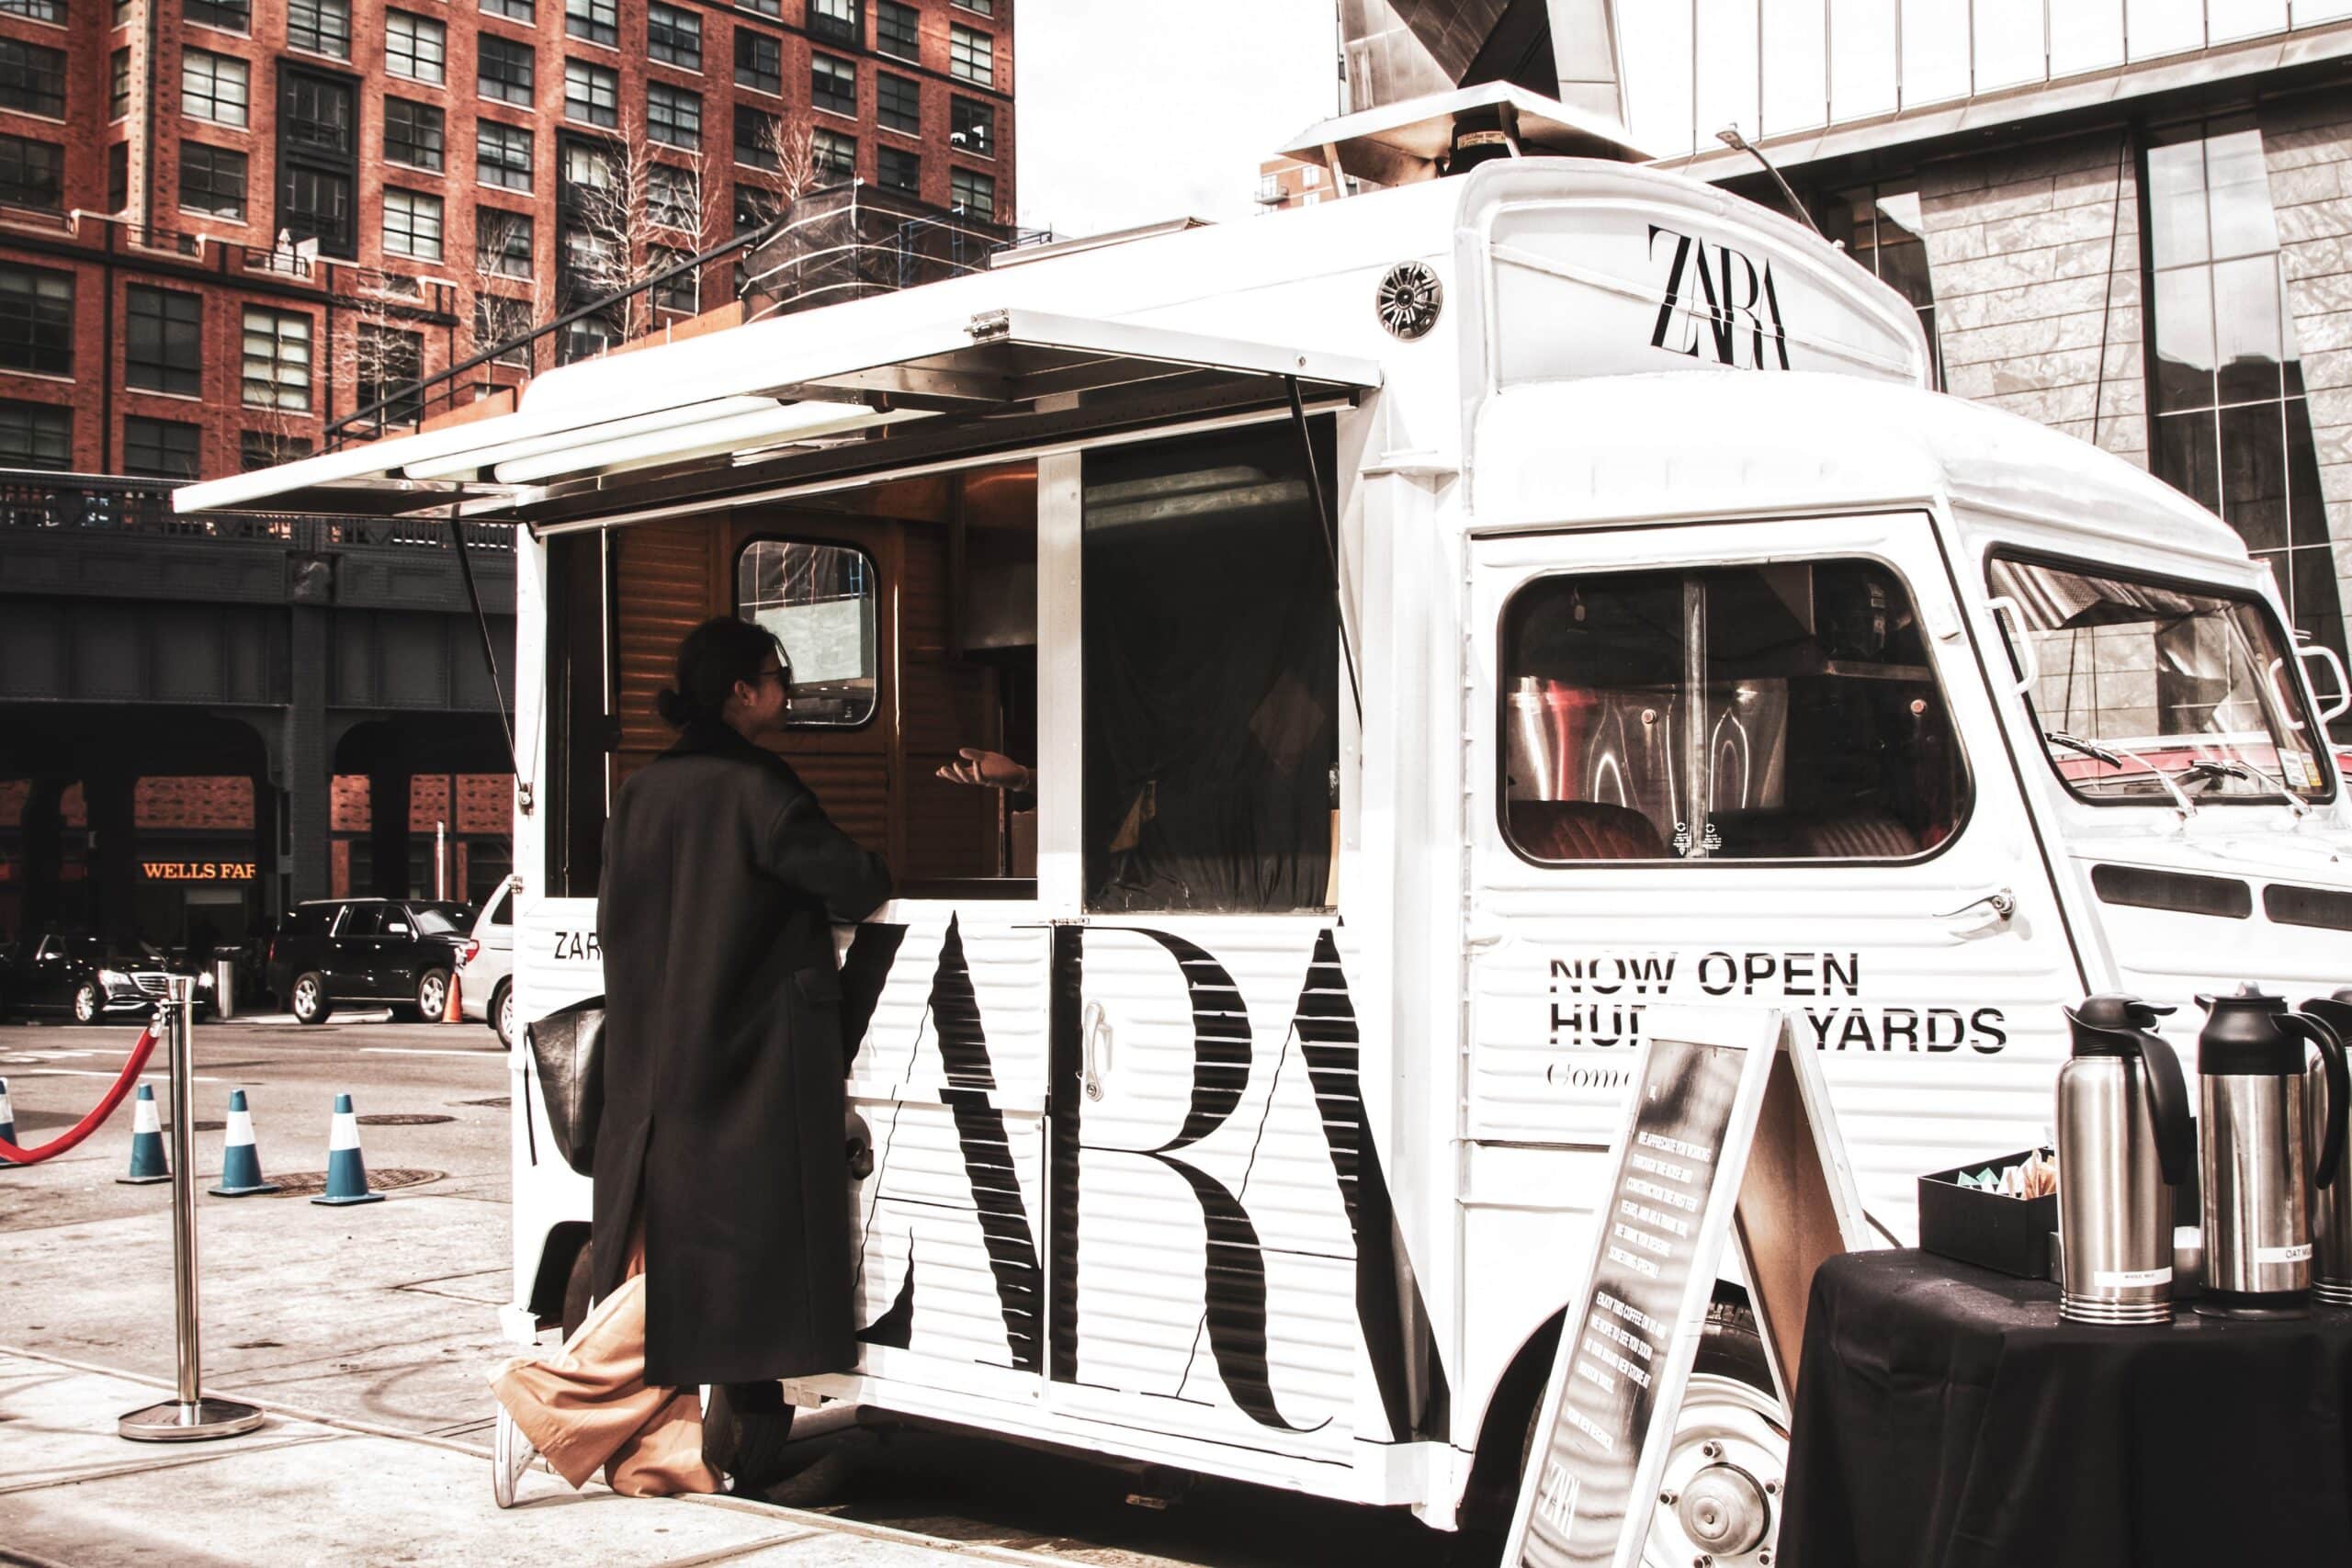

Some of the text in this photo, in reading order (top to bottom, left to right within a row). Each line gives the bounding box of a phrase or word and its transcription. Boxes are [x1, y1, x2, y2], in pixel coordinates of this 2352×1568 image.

[1648, 224, 1790, 371] ZARA
[142, 863, 216, 879] WELLS
[1550, 952, 1860, 997] NOW OPEN
[1803, 1007, 2008, 1055] YARDS
[1546, 1063, 1631, 1089] Com
[2285, 1248, 2301, 1259] OAT
[1623, 1305, 1643, 1326] COFFEE
